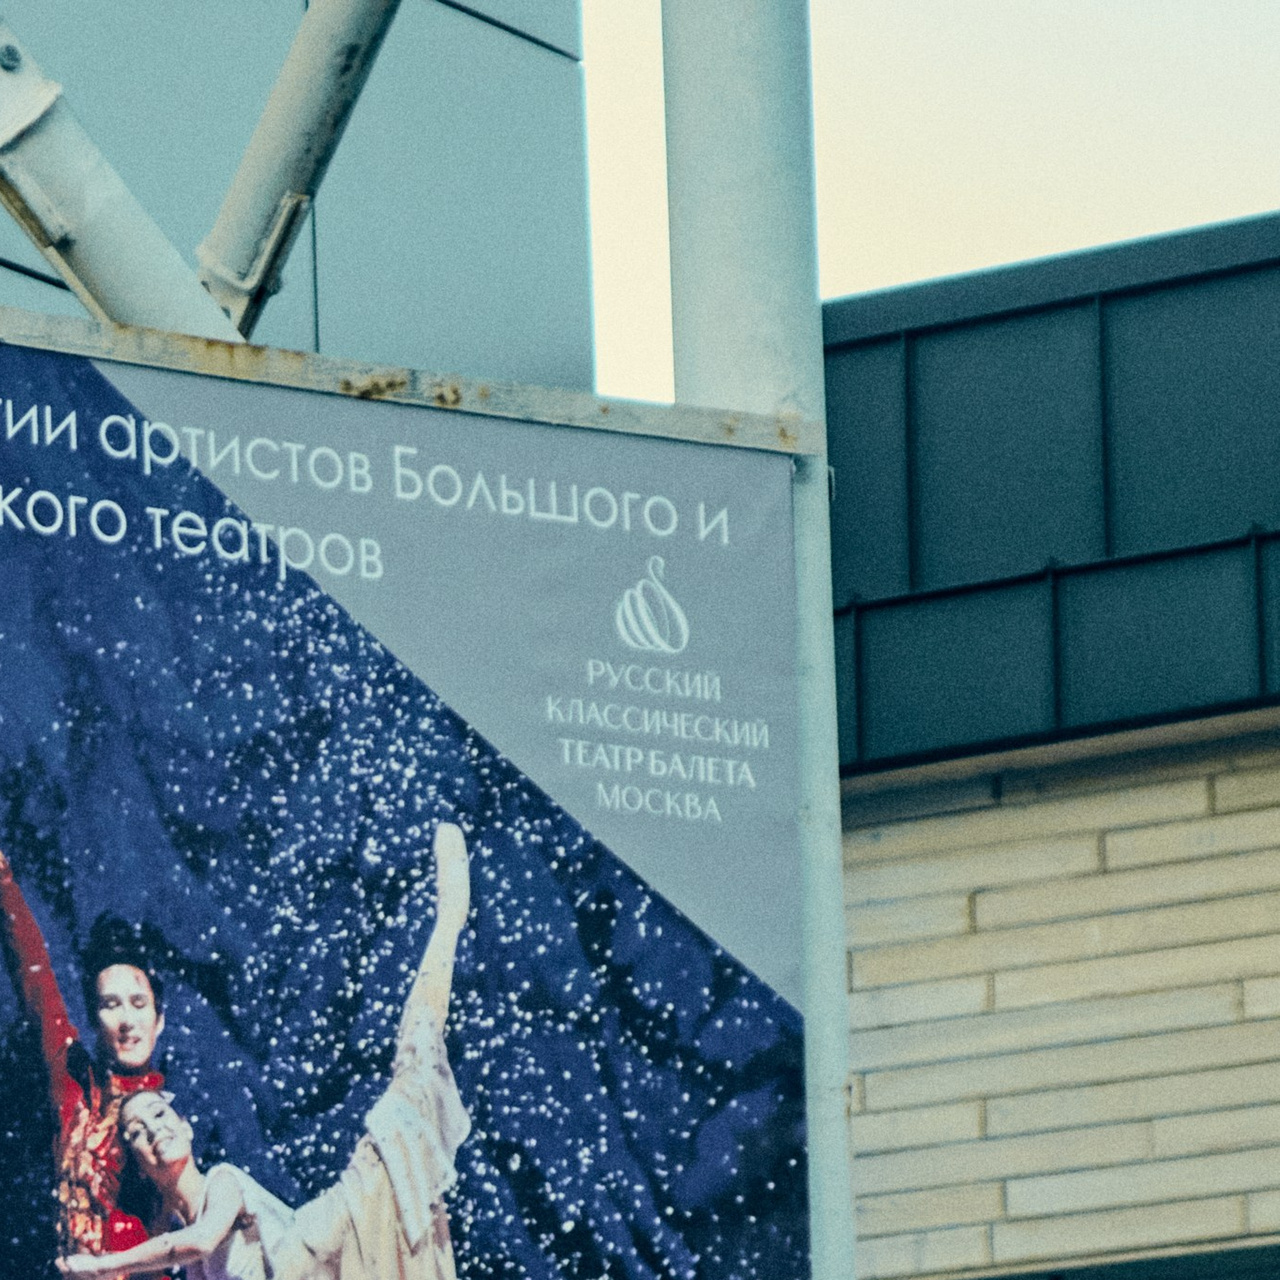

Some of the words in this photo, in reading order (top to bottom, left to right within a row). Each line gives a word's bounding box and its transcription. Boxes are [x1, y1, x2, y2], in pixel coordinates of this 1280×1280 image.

[99, 412, 373, 494] артистов
[393, 445, 679, 536] Большого
[697, 502, 730, 545] и
[144, 504, 385, 581] театров
[586, 658, 722, 701] РУССКИЙ
[545, 695, 771, 749] КЛАССИЧЕСКИЙ
[559, 737, 645, 772] ТЕАТР
[648, 748, 758, 788] БАЛЕТА
[595, 782, 723, 822] МОСКВА
